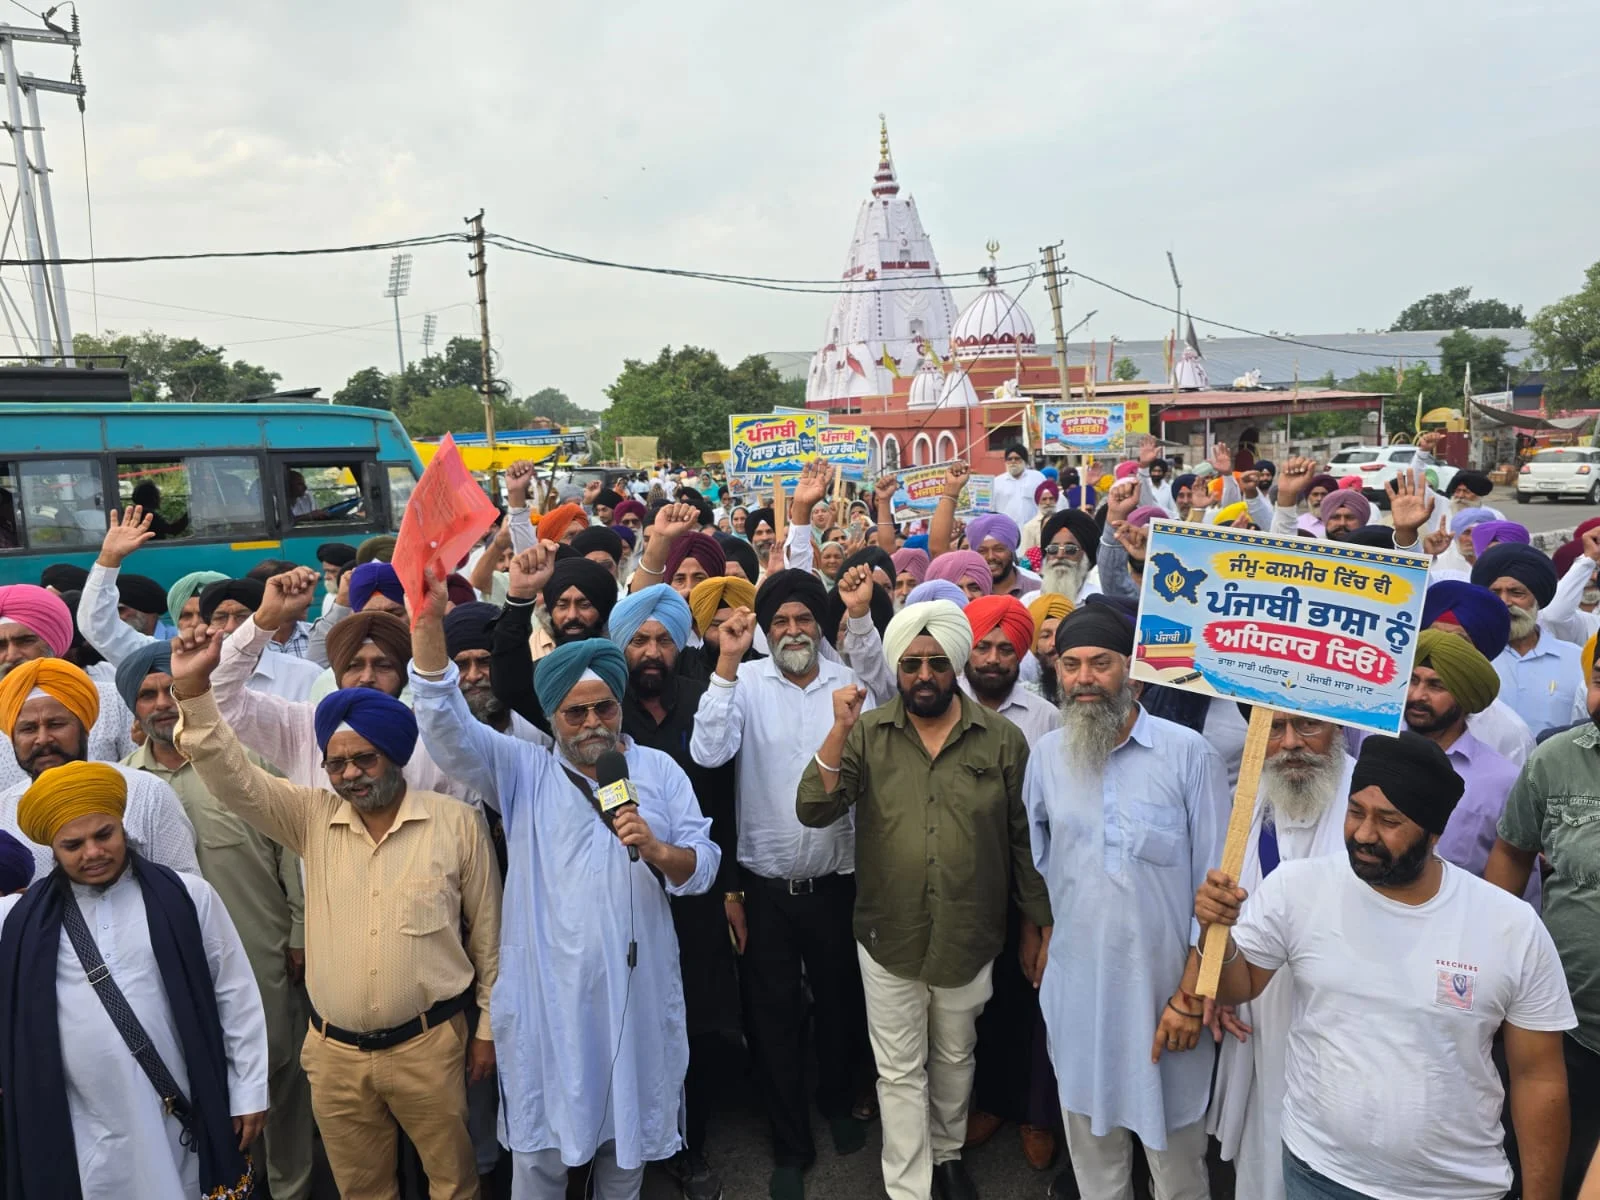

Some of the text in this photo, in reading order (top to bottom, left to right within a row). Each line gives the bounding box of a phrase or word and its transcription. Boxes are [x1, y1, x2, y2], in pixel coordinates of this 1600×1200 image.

[747, 420, 796, 442] ਪੰਜਾਬੀ
[821, 429, 855, 442] ਪੰਜਾਬੀ
[751, 445, 776, 460] ਸਾਡਾ
[778, 442, 800, 456] ਹੱਕ!
[1229, 553, 1392, 595] ਜੰਮੂ-ਕਸ਼ਮੀਰ ਵਿੱਚ ਵੀ
[1206, 582, 1415, 655] ਪੰਜਾਬੀ ਭਾਸ਼ਾ ਨੂੰ
[1155, 630, 1181, 643] ਪੰਜਾਬੀ
[1215, 623, 1388, 679] ਅਧਿਕਾਰ ਦਿਓ!
[1237, 660, 1257, 672] ਸਾਡੀ
[1258, 664, 1290, 678] ਪਹਿਚਾਣ
[1305, 673, 1332, 687] ਪੰਜਾਬੀ
[1334, 680, 1354, 691] ਸਾਡਾ
[1355, 684, 1374, 696] ਮਾਣ
[1436, 959, 1478, 972] SKECHERS
